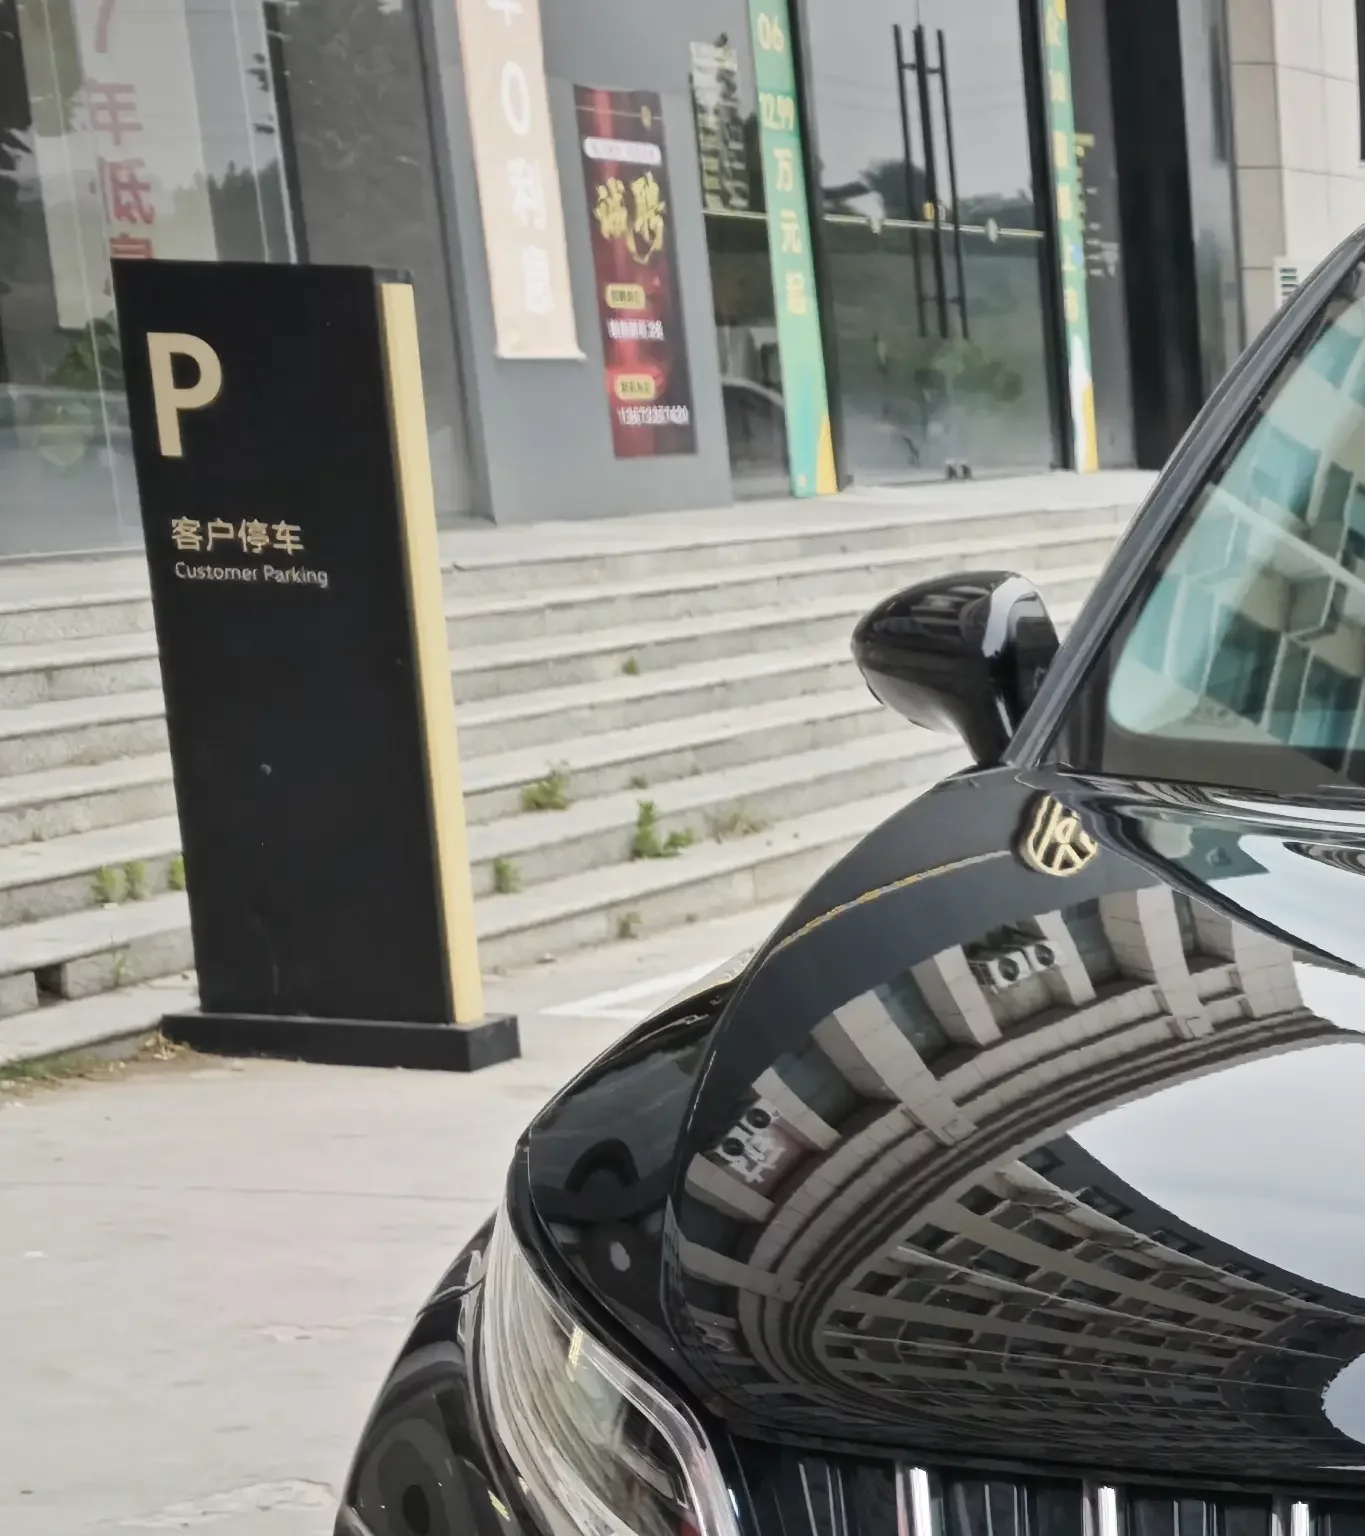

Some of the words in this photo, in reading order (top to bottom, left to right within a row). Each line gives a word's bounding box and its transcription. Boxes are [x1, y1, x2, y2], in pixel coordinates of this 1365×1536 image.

[147, 332, 222, 457] P
[171, 515, 305, 555] 客户停车
[174, 561, 258, 582] Customer
[263, 564, 330, 589] Parking
